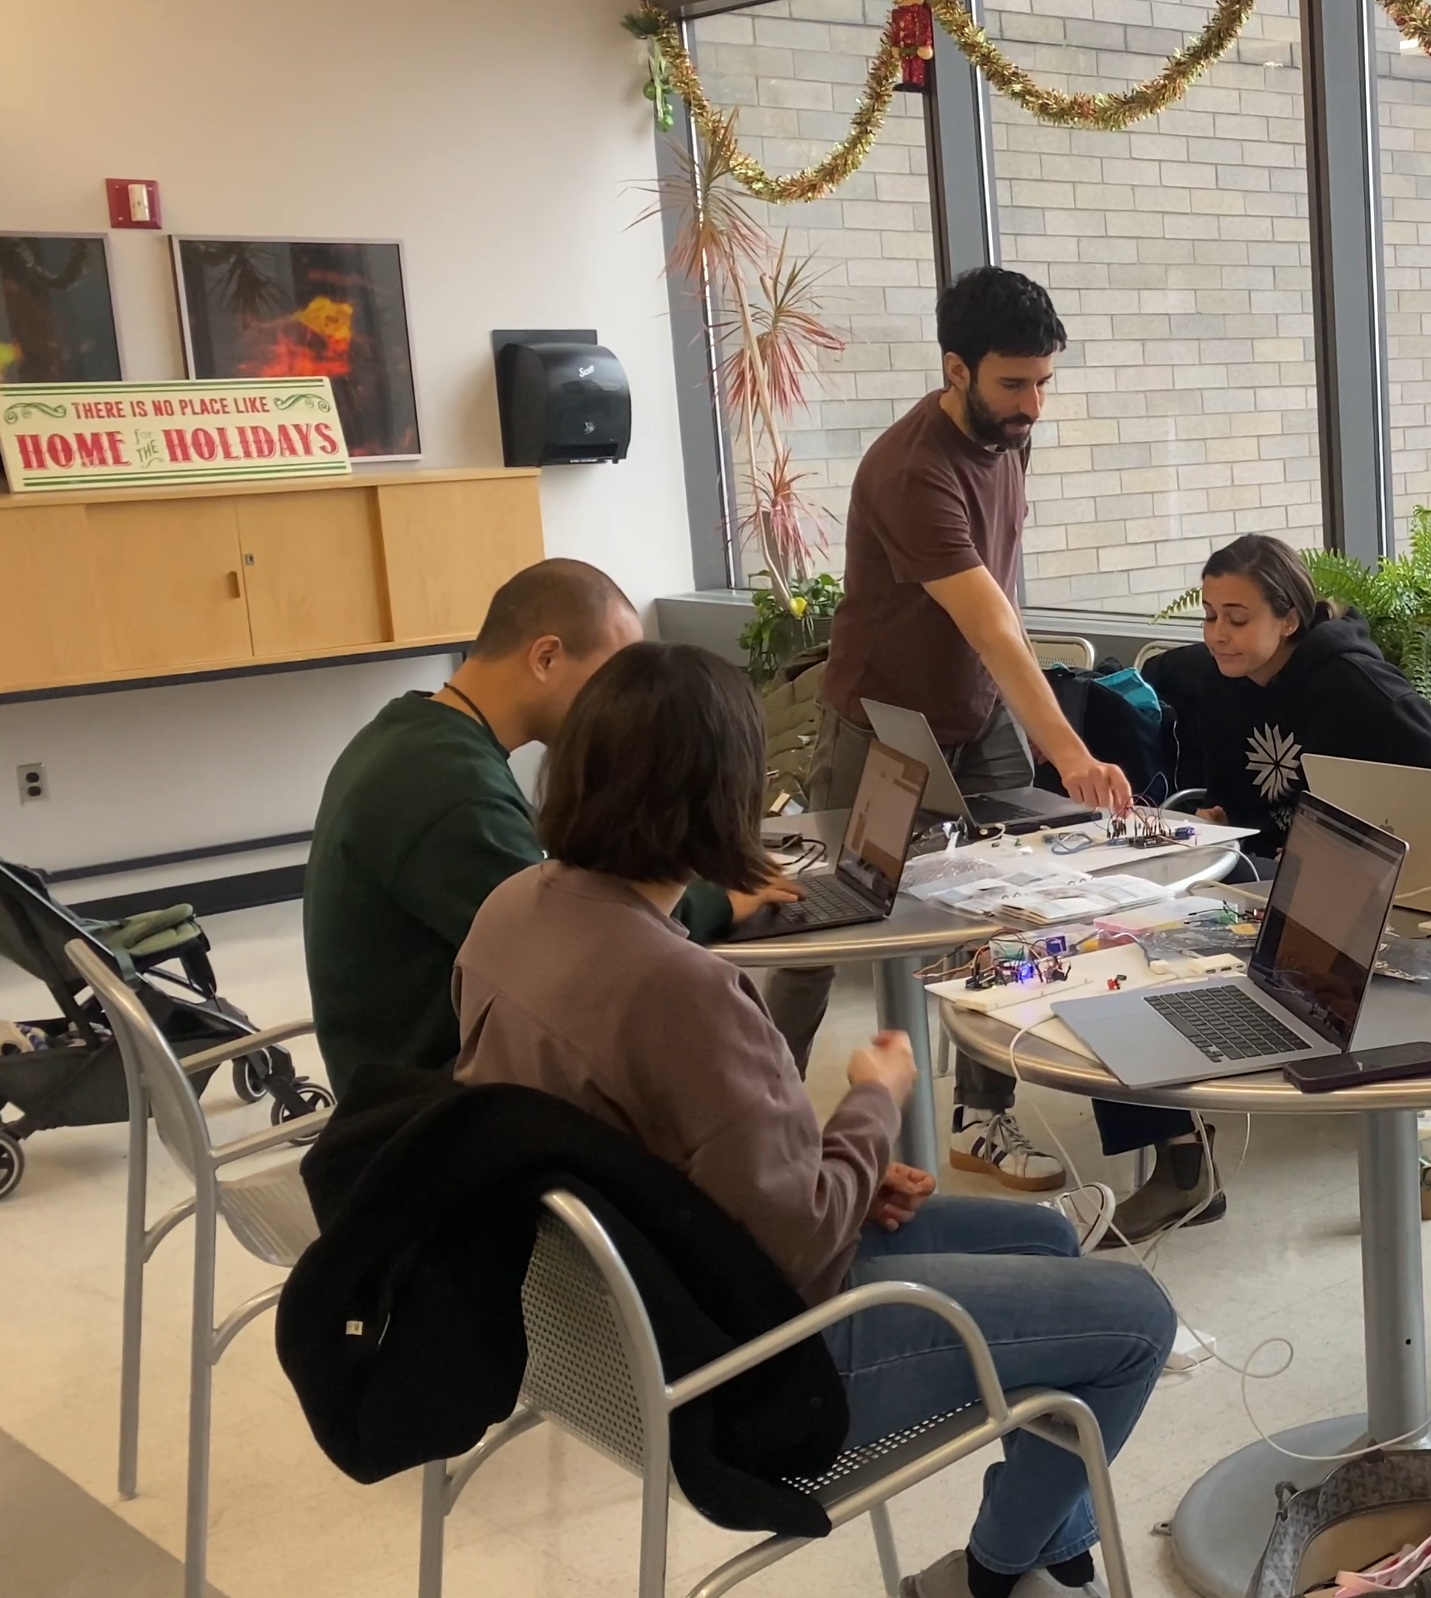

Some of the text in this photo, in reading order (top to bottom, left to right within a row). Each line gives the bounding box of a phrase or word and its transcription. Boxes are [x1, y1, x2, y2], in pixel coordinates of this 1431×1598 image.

[71, 396, 271, 420] THERE IS NO PLACE LIKE
[14, 422, 340, 471] HOME for THE HOLIDAYS
